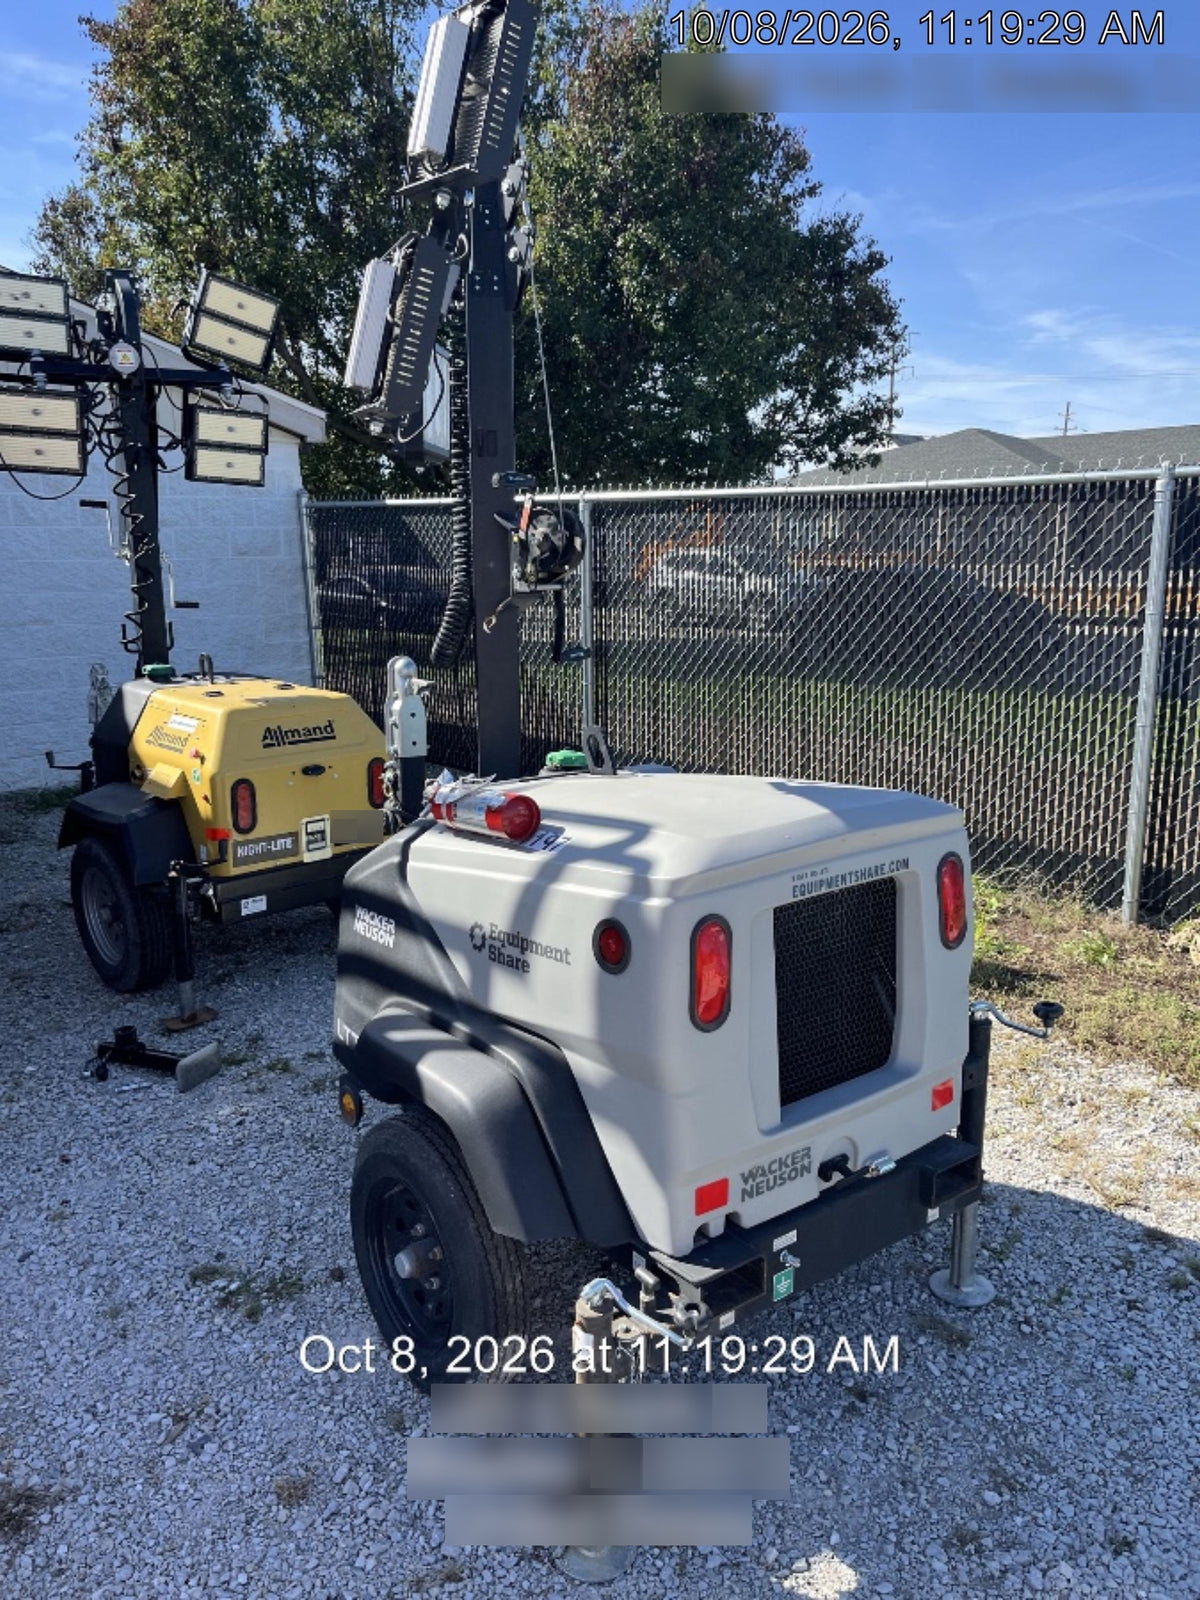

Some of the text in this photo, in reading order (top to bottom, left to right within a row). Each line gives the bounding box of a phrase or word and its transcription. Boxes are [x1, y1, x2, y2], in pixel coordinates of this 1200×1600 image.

[262, 720, 335, 748] Allmand
[792, 857, 910, 898] EQUIPMENTSHARE.COM
[353, 918, 396, 948] NEUSON
[355, 904, 396, 934] WACKER
[488, 922, 571, 966] Equipment
[488, 944, 531, 973] Share
[740, 1146, 811, 1186] WACKER
[741, 1160, 811, 1202] NEUSON
